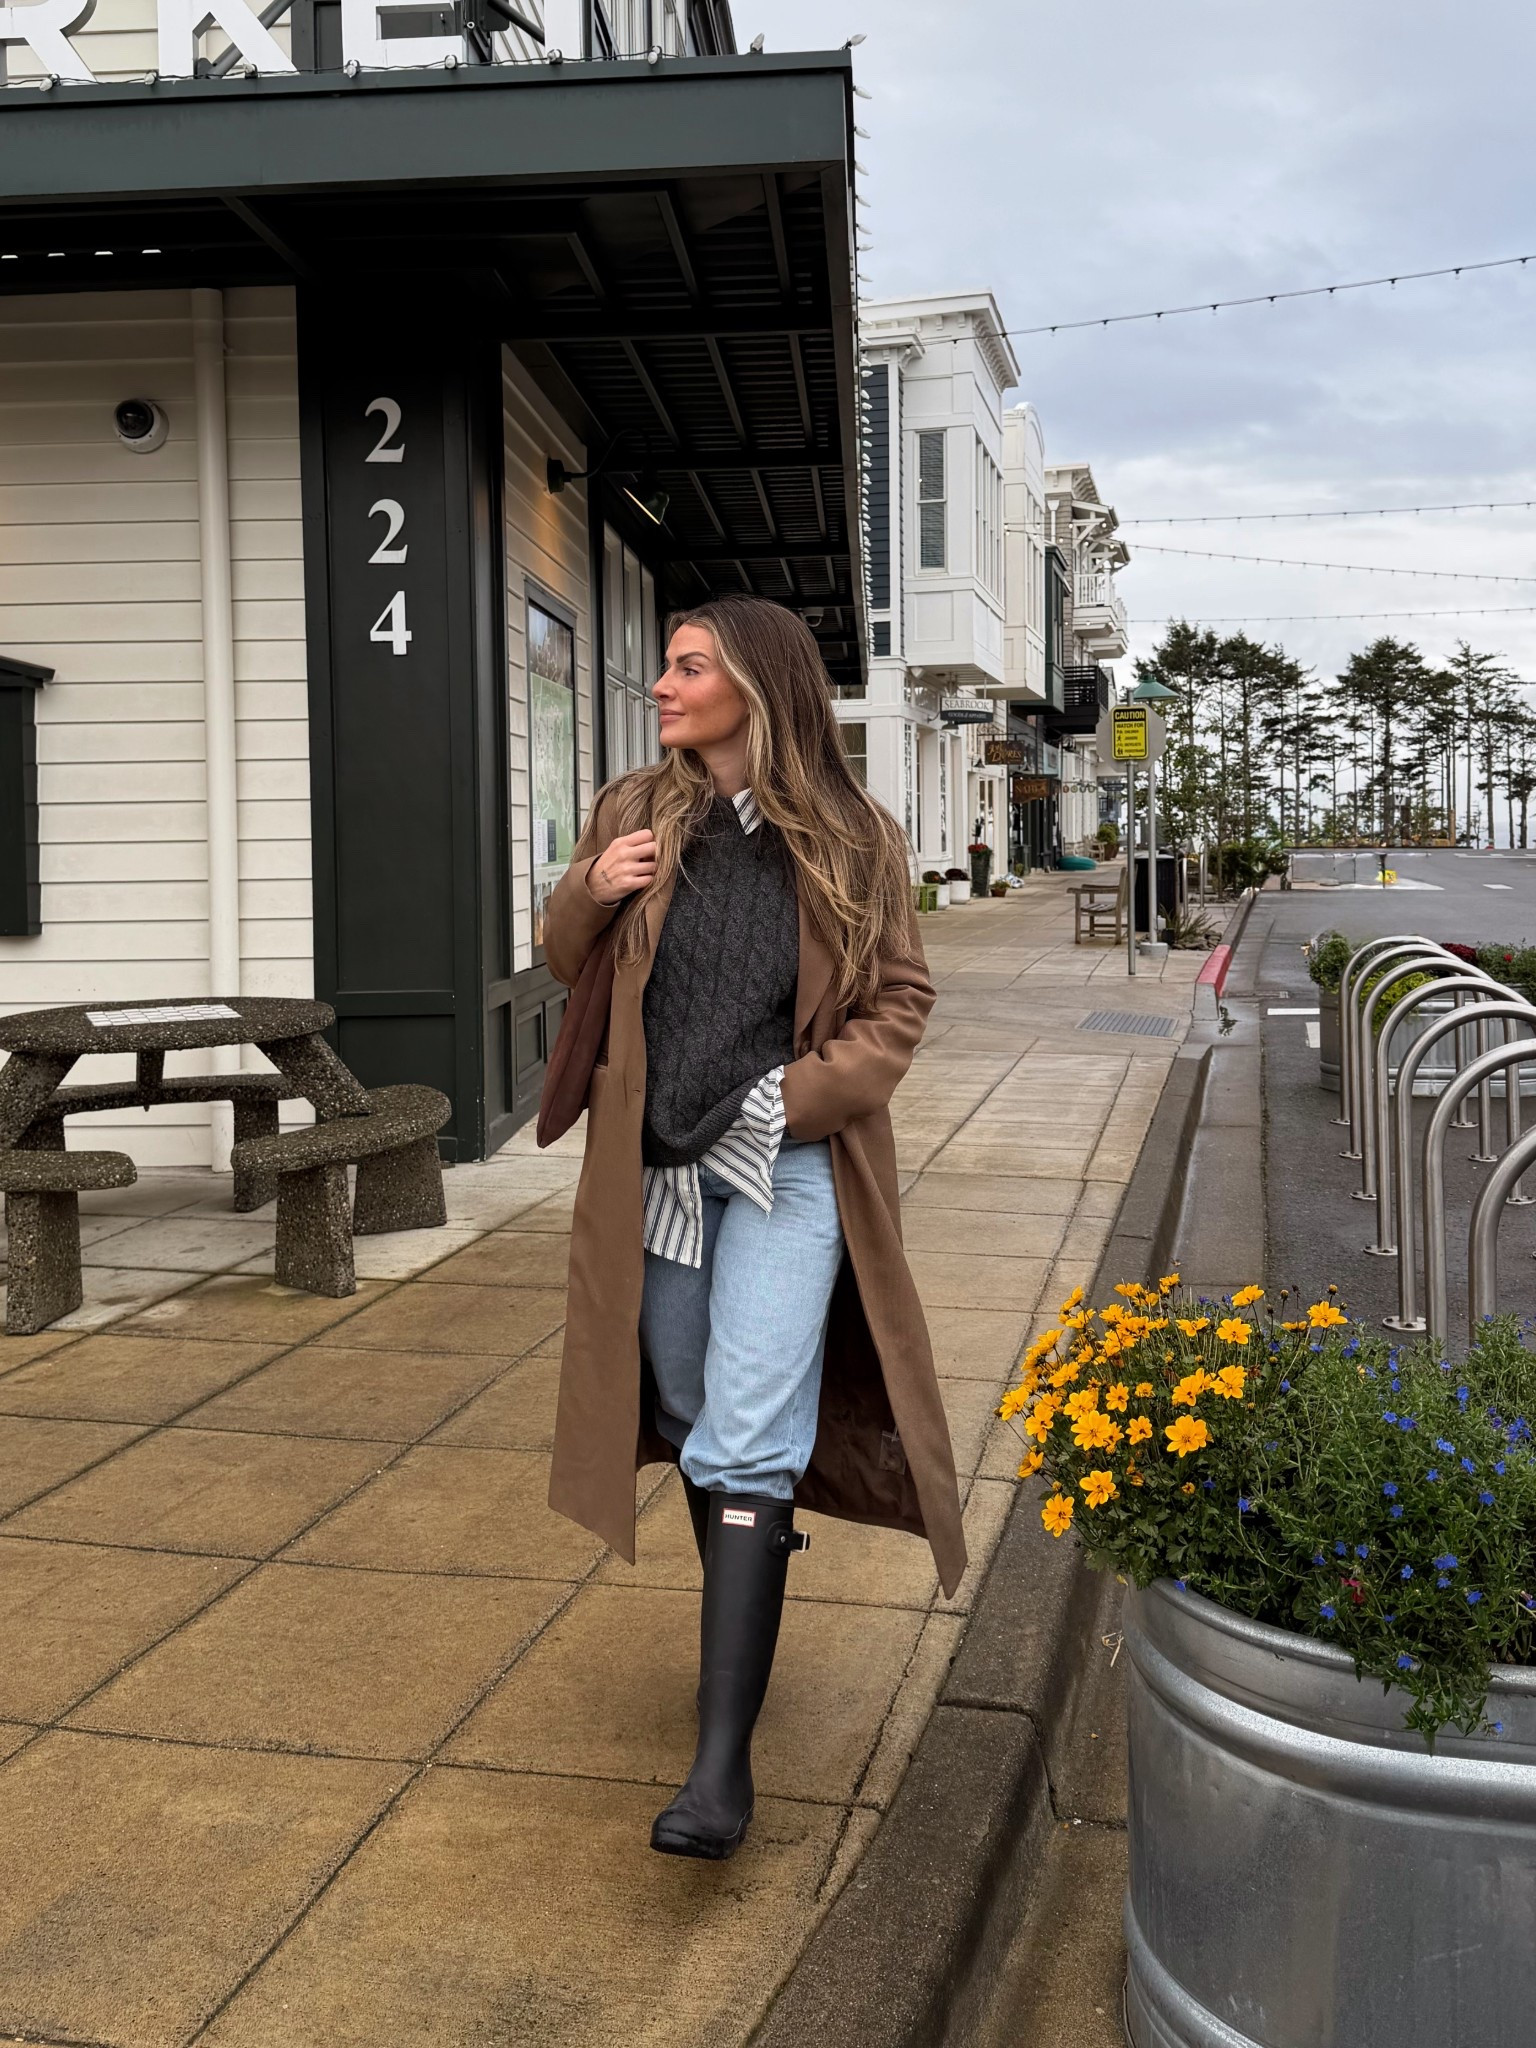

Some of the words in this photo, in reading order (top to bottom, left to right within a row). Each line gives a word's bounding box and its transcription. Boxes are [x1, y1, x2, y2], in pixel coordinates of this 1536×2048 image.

[364, 396, 413, 656] 224
[944, 699, 990, 710] SEABROOK
[1115, 711, 1144, 719] CAUTION
